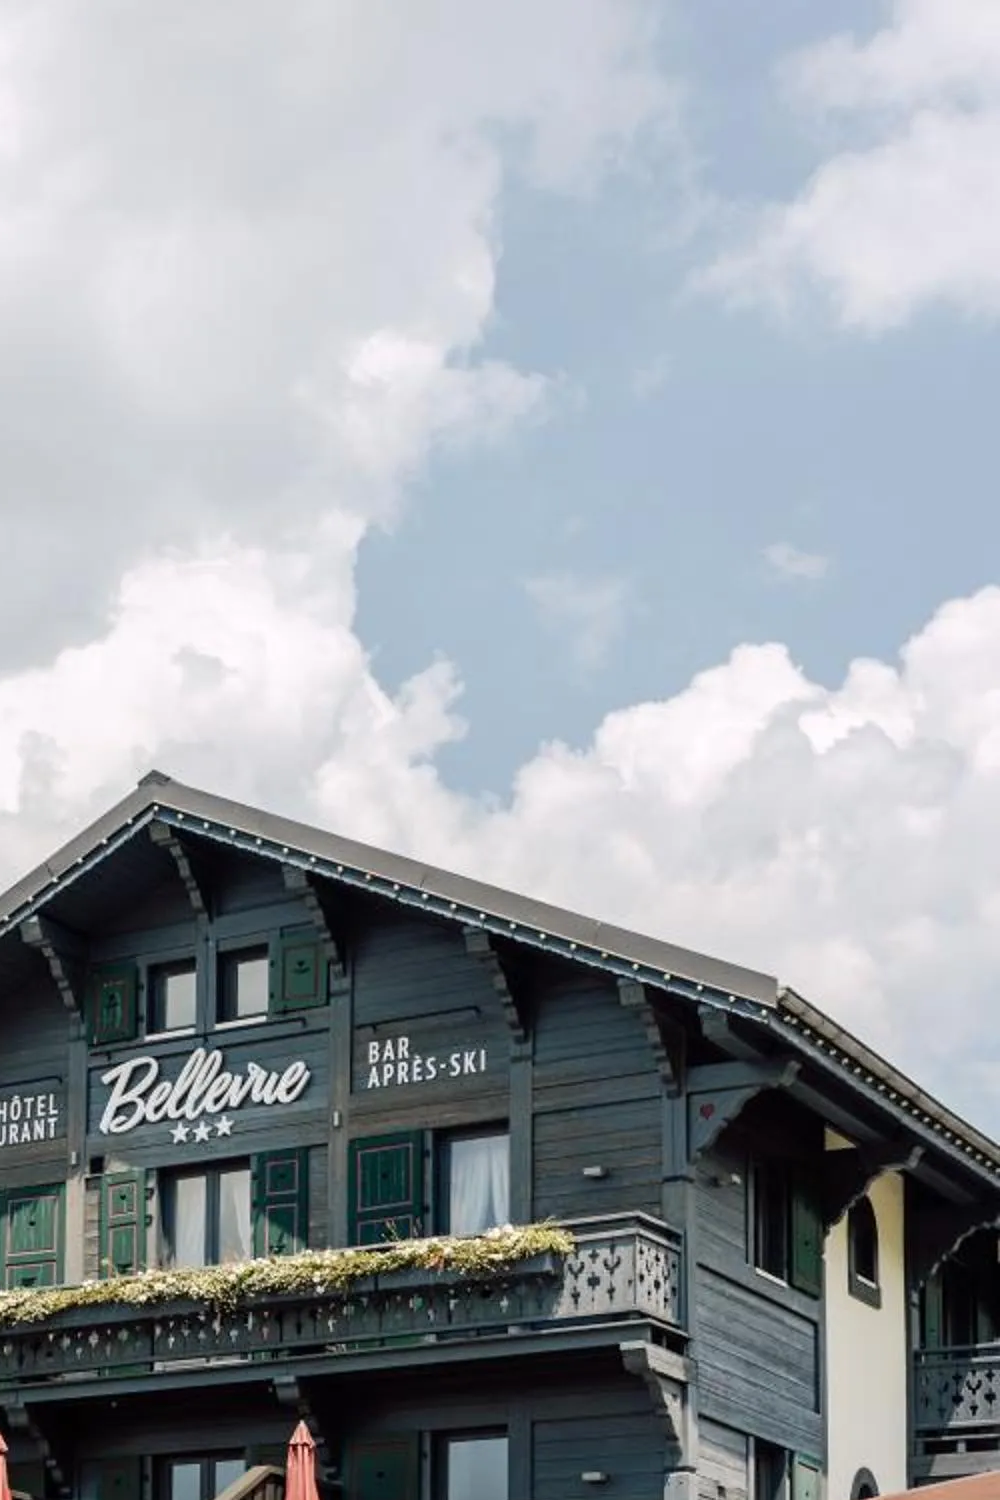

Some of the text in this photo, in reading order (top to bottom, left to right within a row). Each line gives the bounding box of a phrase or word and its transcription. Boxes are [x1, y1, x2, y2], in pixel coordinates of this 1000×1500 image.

[367, 1048, 486, 1089] APRÈS-SKI
[368, 1037, 409, 1065] BAR
[100, 1047, 312, 1134] Bellevue
